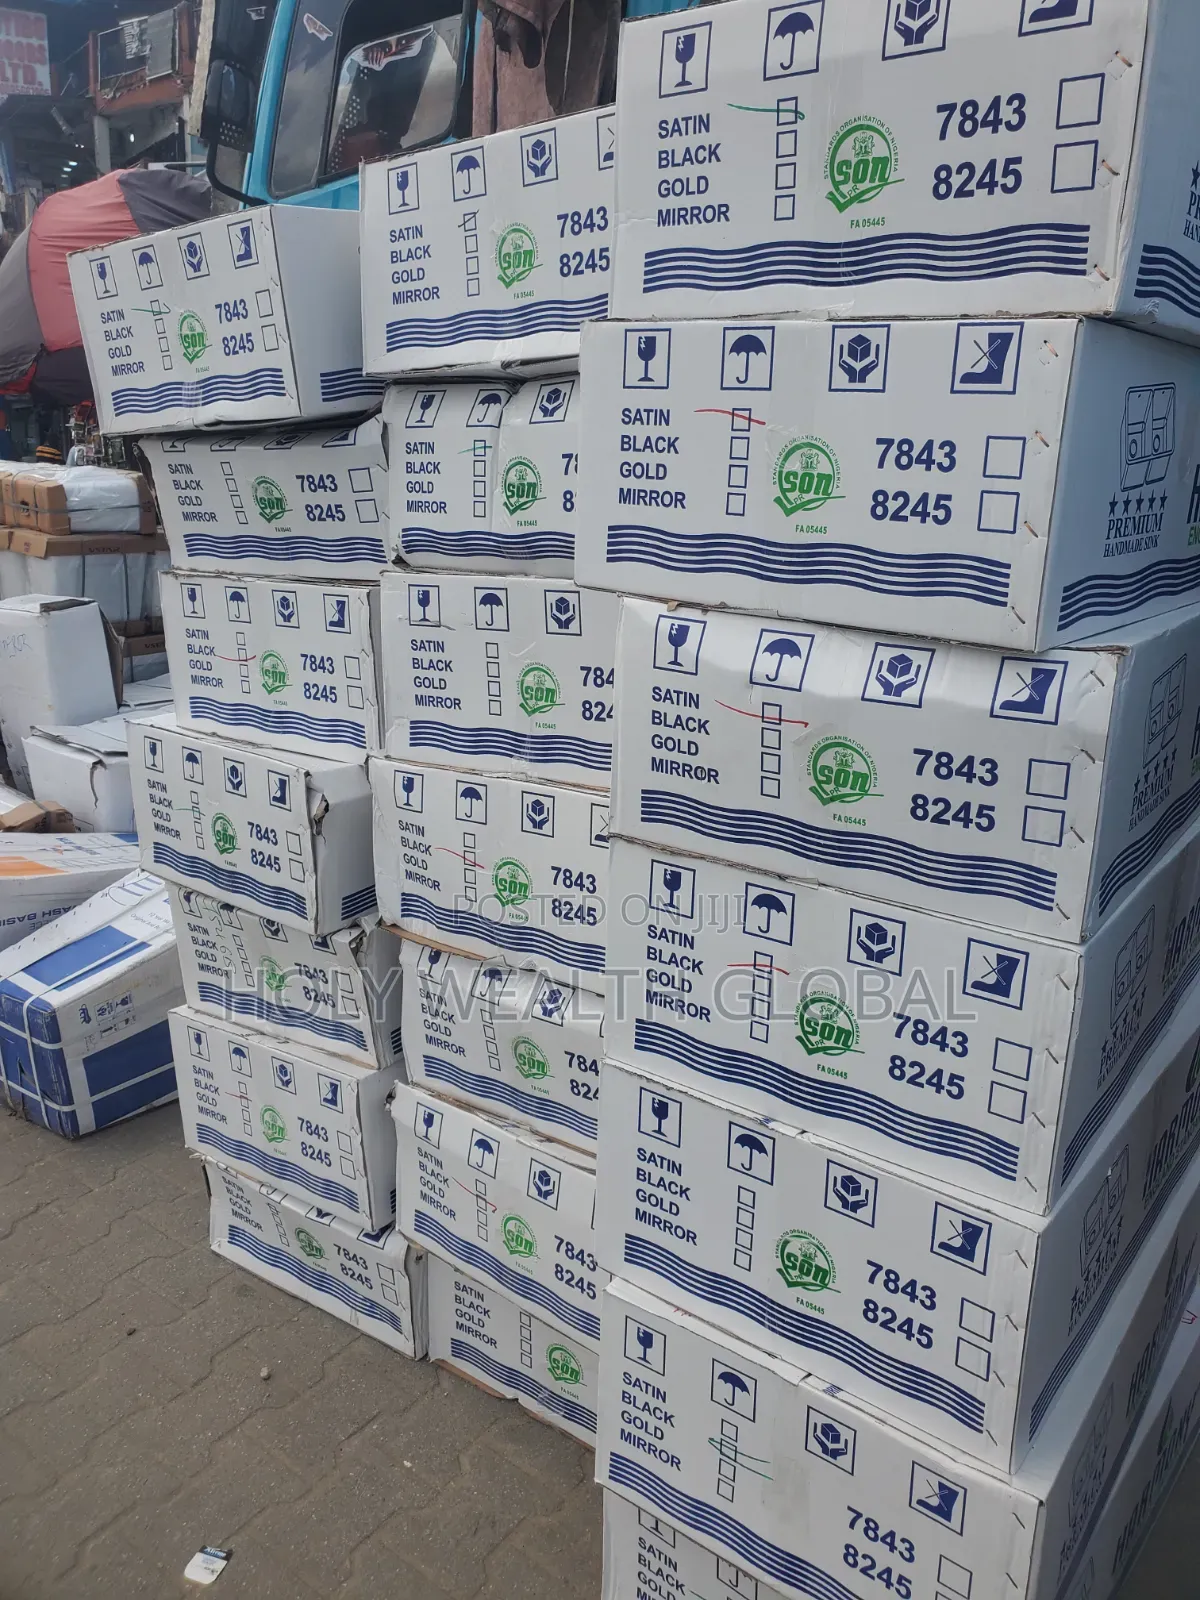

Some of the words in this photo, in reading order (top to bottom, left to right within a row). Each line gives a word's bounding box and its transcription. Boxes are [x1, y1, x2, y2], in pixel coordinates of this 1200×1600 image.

[658, 113, 710, 140] SATIN
[936, 92, 1027, 141] 7843
[658, 143, 721, 169] BLACK
[657, 175, 709, 198] GOLD
[932, 157, 1023, 200] 8245
[557, 206, 609, 238] 7843
[657, 203, 730, 228] MIRROR
[850, 220, 860, 229] FA
[862, 217, 885, 227] 05445
[389, 224, 423, 244] SATIN
[390, 245, 431, 264] BLACK
[559, 247, 610, 278] 8245
[391, 268, 425, 284] GOLD
[392, 286, 440, 305] MIRROR
[101, 309, 125, 324] SATIN
[215, 299, 248, 324] 7843
[104, 326, 133, 342] BLACK
[222, 332, 254, 356] 8245
[108, 345, 132, 359] GOLD
[111, 361, 145, 376] MIRROR
[621, 408, 671, 426] SATIN
[405, 442, 434, 454] SATIN
[620, 434, 679, 455] BLACK
[875, 437, 957, 473] 7843
[168, 463, 193, 474] SATIN
[406, 462, 441, 474] BLACK
[619, 461, 667, 480] GOLD
[173, 480, 203, 491] BLACK
[296, 474, 338, 493] 7843
[406, 481, 434, 493] GOLD
[178, 496, 202, 506] GOLD
[406, 500, 447, 514] MIRROR
[618, 487, 686, 509] MIRROR
[870, 489, 952, 526] 8245
[182, 511, 218, 522] MIRROR
[305, 504, 346, 522] 8245
[796, 525, 804, 533] FA
[806, 525, 827, 534] 05445
[1106, 512, 1164, 540] PREMIUM
[1103, 539, 1142, 558] HANDMADE
[1143, 534, 1160, 550] SINK
[186, 628, 209, 640] SATIN
[187, 644, 215, 657] BLACK
[410, 639, 445, 653] SATIN
[189, 660, 212, 671] GOLD
[300, 653, 335, 675] 7843
[412, 658, 453, 672] BLACK
[191, 675, 224, 689] MIRROR
[414, 676, 447, 690] GOLD
[580, 665, 614, 689] 784
[303, 683, 337, 704] 8245
[415, 694, 462, 710] MIRROR
[651, 686, 700, 709] SATIN
[582, 700, 613, 722] 824
[651, 710, 710, 736] BLACK
[651, 734, 699, 757] GOLD
[650, 757, 720, 785] MIRROR
[913, 748, 1000, 788] 7843
[147, 779, 167, 794] SATIN
[149, 793, 173, 810] BLACK
[152, 808, 171, 823] GOLD
[833, 813, 842, 822] FA
[844, 816, 866, 826] 05445
[909, 794, 997, 833] 8245
[153, 822, 181, 840] MIRROR
[247, 821, 278, 846] 7843
[398, 820, 425, 837] SATIN
[401, 836, 432, 856] BLACK
[251, 849, 281, 873] 8245
[403, 853, 428, 871] GOLD
[405, 869, 441, 892] MIRROR
[551, 866, 597, 894] 7843
[0, 913, 37, 927] BASI
[42, 905, 77, 918] ASH
[551, 898, 597, 926] 8245
[187, 923, 210, 937] SATIN
[647, 923, 695, 951] SATIN
[192, 937, 219, 952] BLACK
[195, 949, 217, 963] GOLD
[646, 946, 704, 976] BLACK
[197, 963, 230, 979] MIRROR
[294, 963, 328, 985] 7843
[646, 967, 693, 994] GOLD
[303, 986, 335, 1008] 8245
[419, 988, 447, 1007] SATIN
[645, 989, 711, 1023] MIRROR
[421, 1004, 456, 1025] BLACK
[423, 1019, 452, 1037] GOLD
[892, 1012, 969, 1059] 7843
[425, 1034, 466, 1057] MIRROR
[193, 1065, 214, 1080] SATIN
[564, 1050, 599, 1077] 784
[817, 1064, 825, 1072] FA
[827, 1067, 848, 1079] 05445
[194, 1078, 220, 1096] BLACK
[888, 1054, 966, 1101] 8245
[196, 1092, 217, 1108] GOLD
[570, 1079, 599, 1101] 82
[198, 1105, 227, 1125] MIRROR
[297, 1117, 329, 1143] 7843
[301, 1142, 332, 1167] 8245
[417, 1147, 443, 1170] SATIN
[637, 1147, 682, 1177] SATIN
[419, 1161, 450, 1188] BLACK
[636, 1167, 691, 1201] BLACK
[420, 1176, 445, 1199] GOLD
[420, 1190, 457, 1221] MIRROR
[635, 1188, 680, 1217] GOLD
[634, 1207, 697, 1247] MIRROR
[554, 1235, 597, 1272] 7843
[454, 1281, 484, 1303] SATIN
[554, 1263, 597, 1300] 8245
[866, 1259, 937, 1312] 7843
[454, 1294, 491, 1319] BLACK
[796, 1297, 805, 1307] FA
[806, 1301, 825, 1315] 05445
[455, 1308, 485, 1329] GOLD
[862, 1298, 933, 1350] 8245
[456, 1321, 498, 1349] MIRROR
[622, 1371, 667, 1404] SATIN
[622, 1390, 676, 1429] BLACK
[620, 1410, 665, 1443] GOLD
[619, 1428, 682, 1472] MIRROR
[847, 1505, 915, 1563] 7843
[638, 1537, 678, 1572] SATIN
[638, 1552, 686, 1596] BLACK
[843, 1543, 912, 1599] 8245
